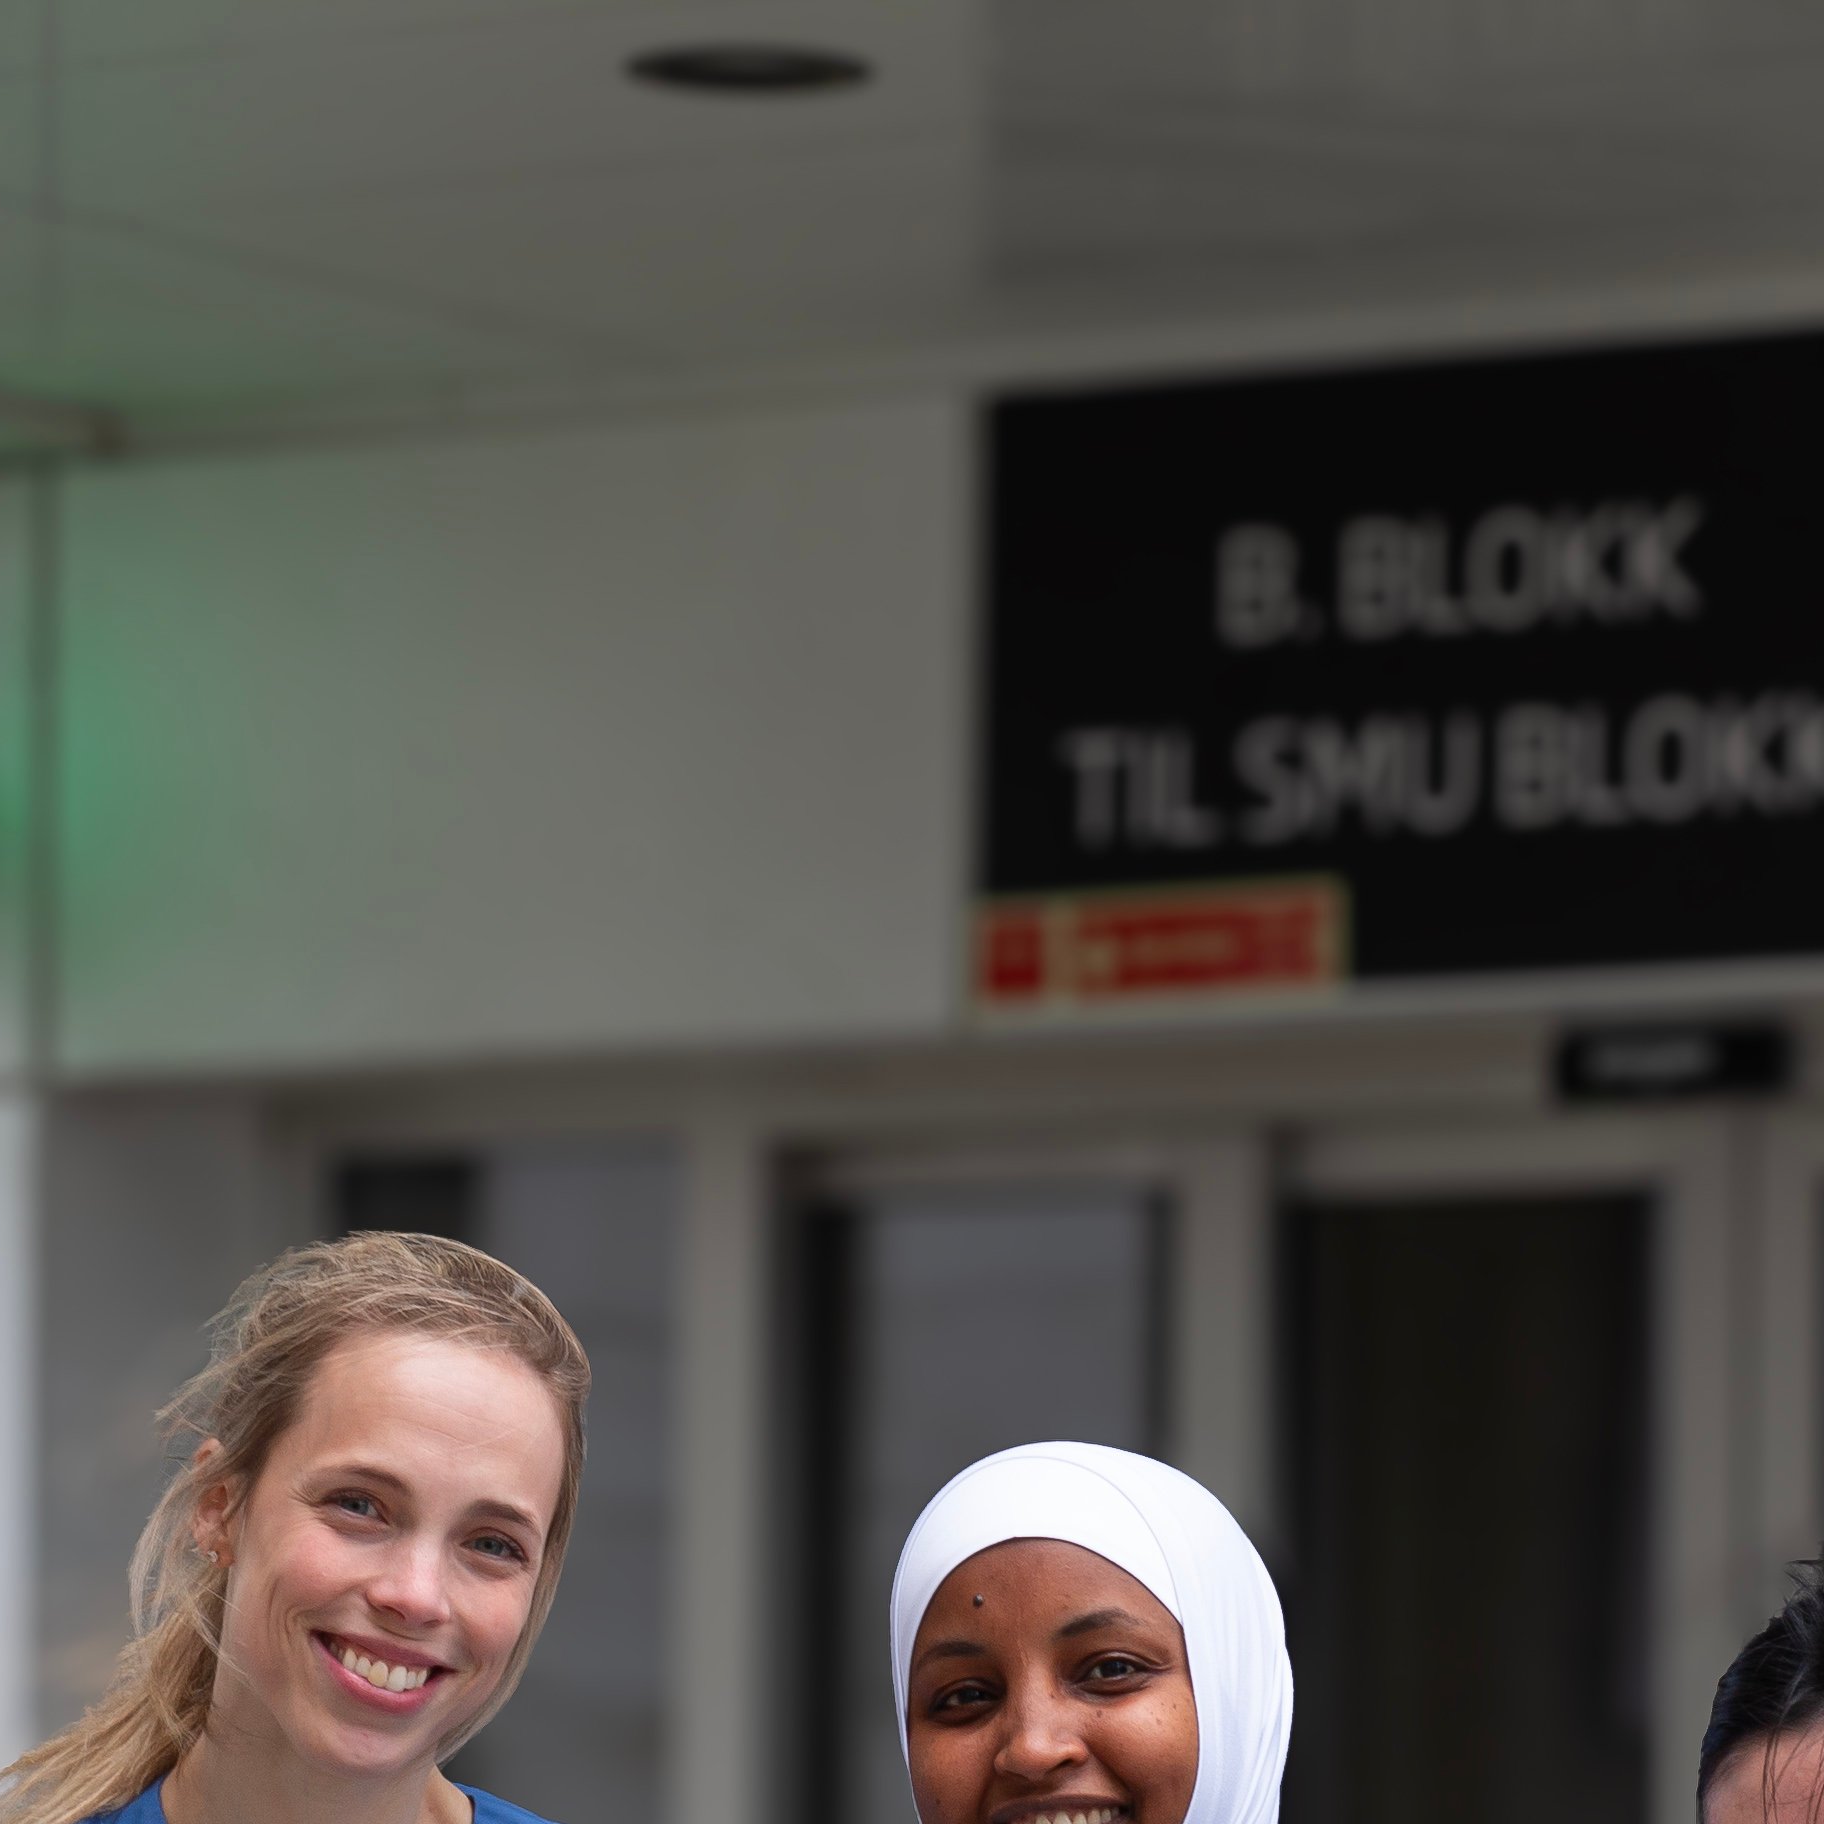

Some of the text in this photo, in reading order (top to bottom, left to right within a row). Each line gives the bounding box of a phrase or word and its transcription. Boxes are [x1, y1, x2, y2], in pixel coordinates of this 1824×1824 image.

[1214, 494, 1702, 646] B. BLOKK
[1057, 724, 1225, 849] TIL
[1232, 707, 1482, 843] SMU
